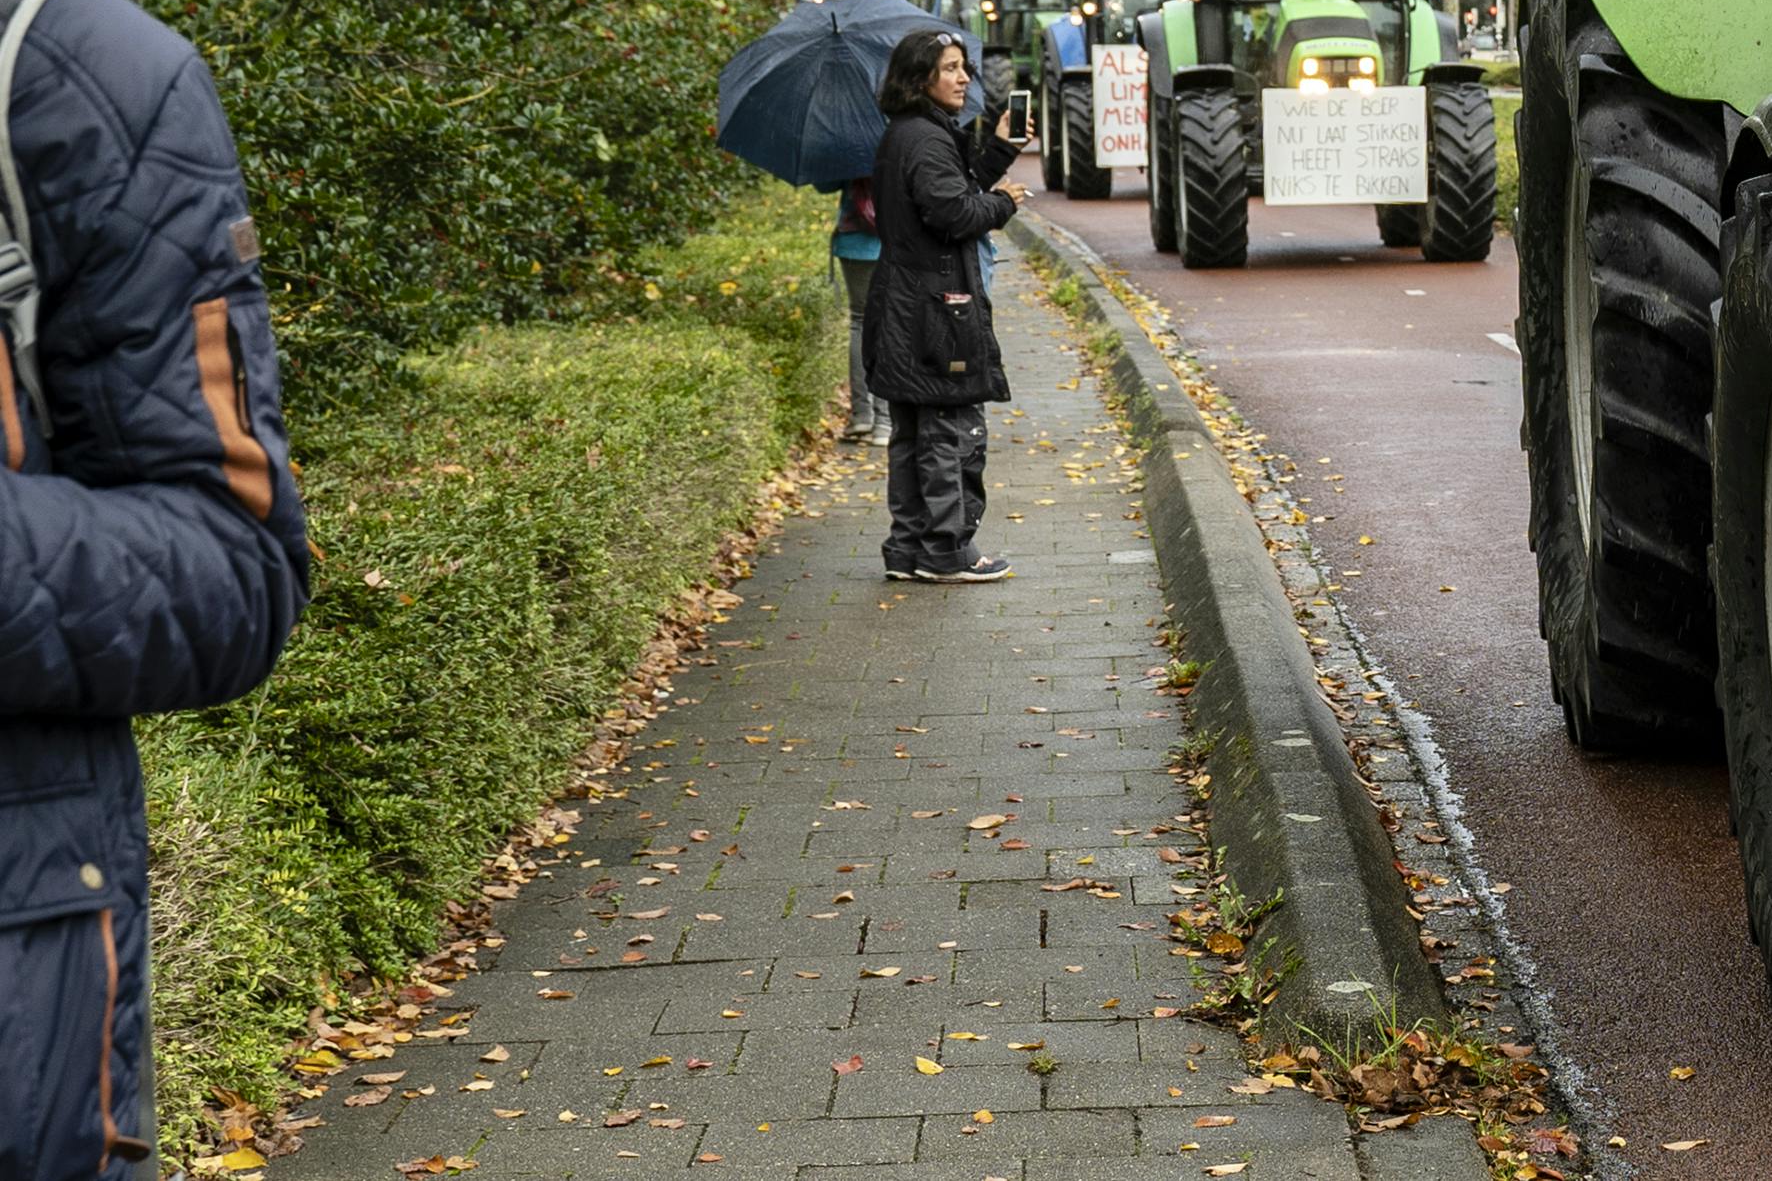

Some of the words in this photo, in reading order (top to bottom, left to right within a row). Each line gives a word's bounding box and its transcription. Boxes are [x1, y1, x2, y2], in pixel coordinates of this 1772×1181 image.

[1099, 50, 1148, 76] ALS
[1327, 99, 1347, 117] DE
[1361, 97, 1399, 117] BOER
[1102, 134, 1148, 153] ONH
[1317, 126, 1347, 145] LAAT
[1291, 147, 1342, 171] HEEFT
[1356, 146, 1420, 169] STRAKS
[1325, 174, 1343, 197] TE
